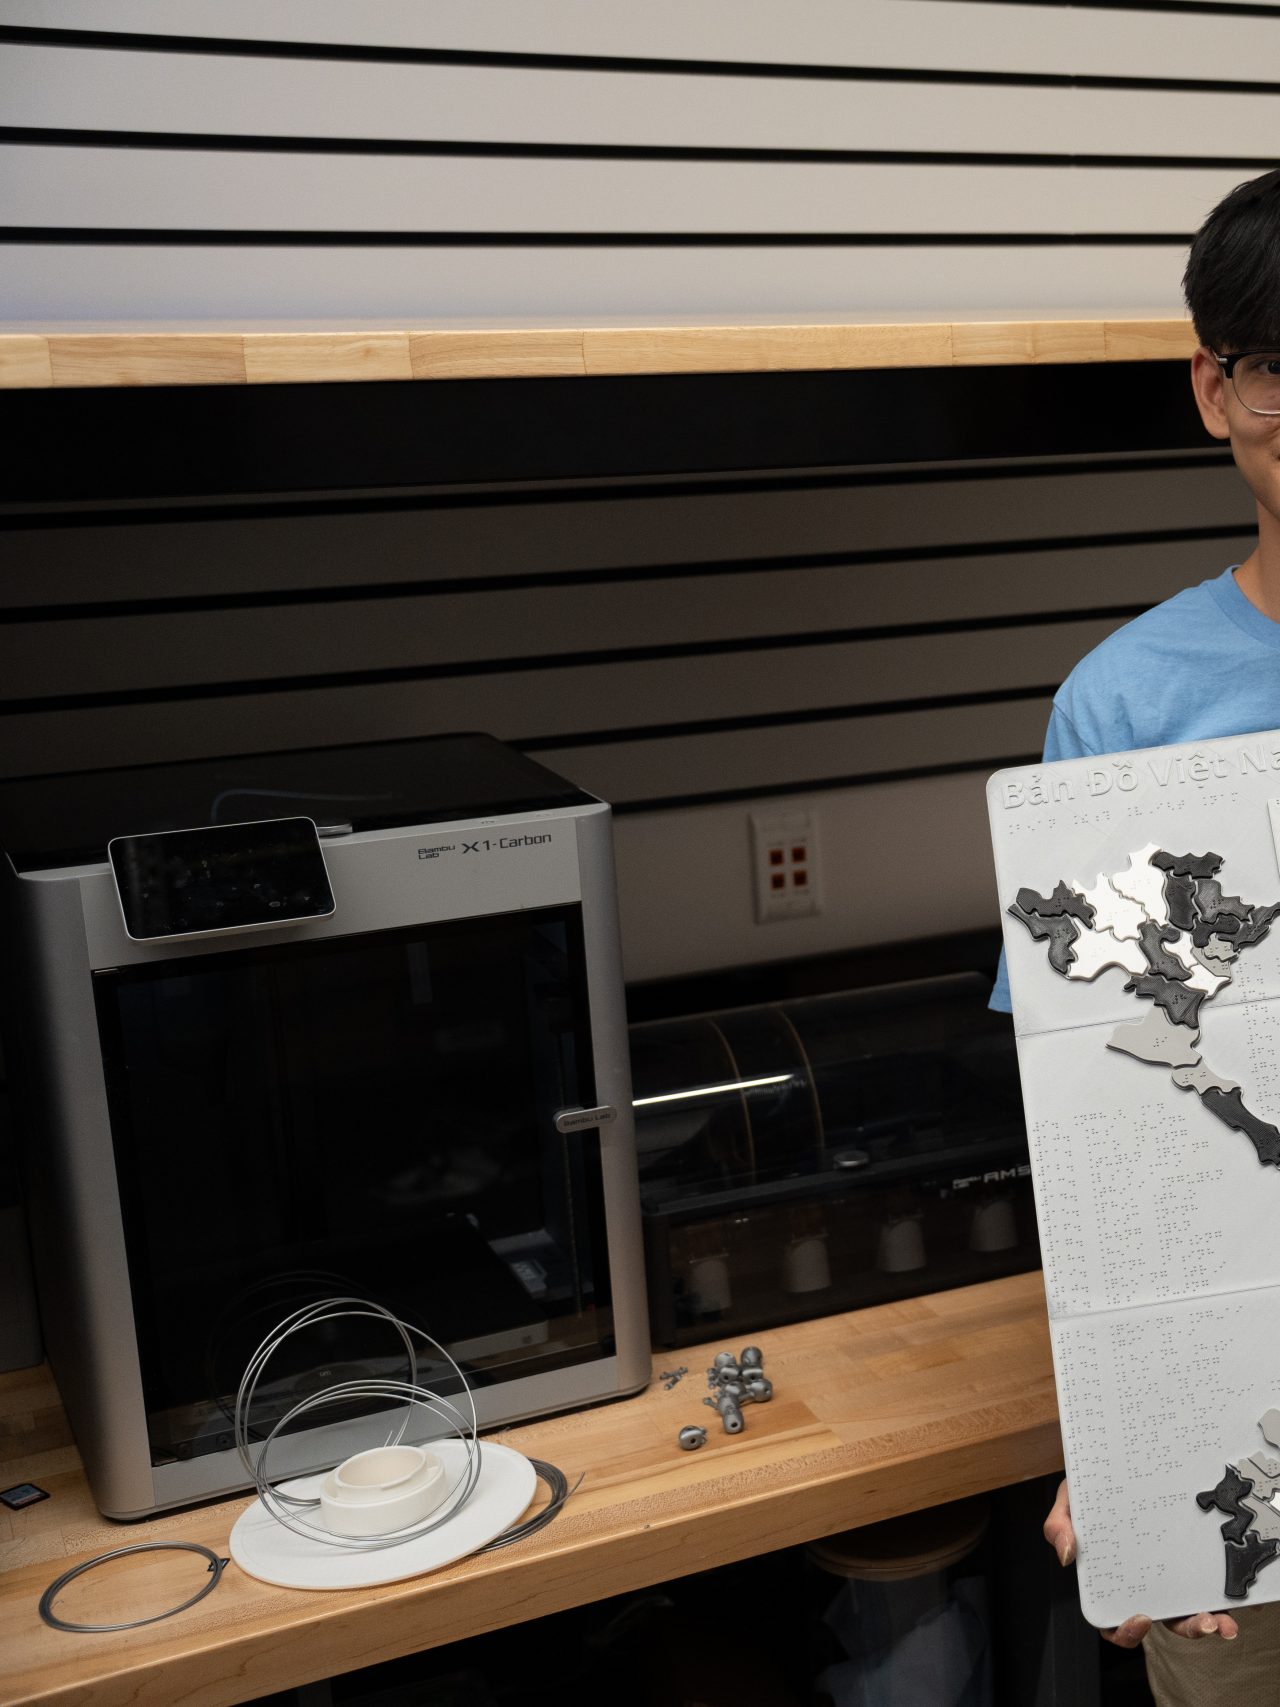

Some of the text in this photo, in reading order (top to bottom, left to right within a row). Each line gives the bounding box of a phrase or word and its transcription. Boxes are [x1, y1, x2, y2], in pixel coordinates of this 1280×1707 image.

[1001, 774, 1076, 810] Bản
[1087, 759, 1140, 798] Đồ
[1147, 751, 1228, 790] Việt
[418, 844, 456, 855] Bambu
[418, 852, 440, 860] Lab
[983, 1164, 1031, 1183] AMS
